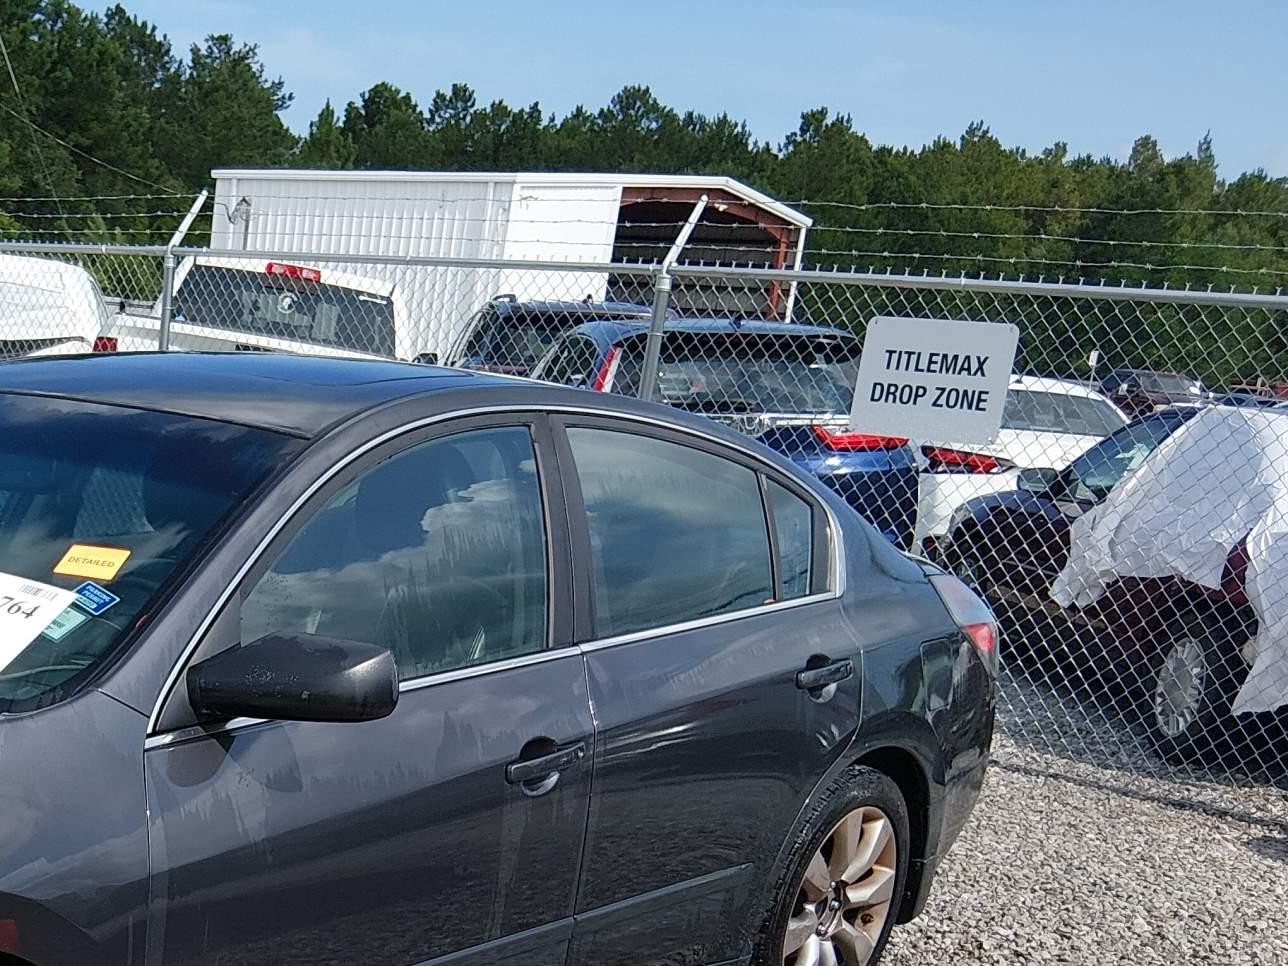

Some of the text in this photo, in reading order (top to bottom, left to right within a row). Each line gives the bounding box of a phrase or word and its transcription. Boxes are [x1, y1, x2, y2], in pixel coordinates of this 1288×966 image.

[885, 349, 989, 377] TITLEMAX
[870, 382, 990, 412] DROP ZONE
[67, 555, 116, 568] DETAILED
